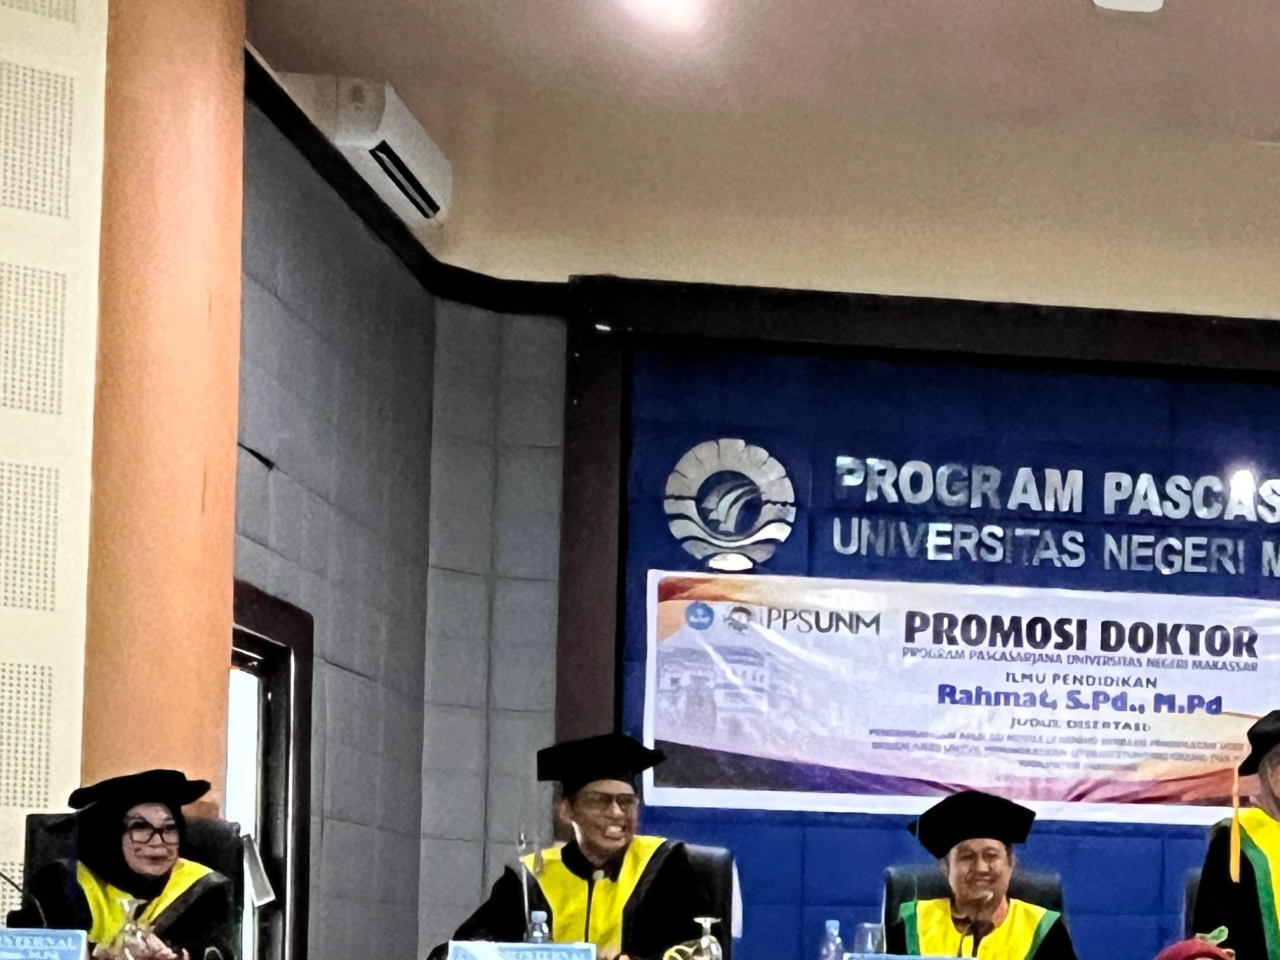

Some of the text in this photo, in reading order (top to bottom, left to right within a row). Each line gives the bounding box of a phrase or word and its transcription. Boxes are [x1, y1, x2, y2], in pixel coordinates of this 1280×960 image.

[835, 455, 1084, 513] PROGRAM
[833, 516, 1086, 568] UNIVERSITAS
[1103, 533, 1246, 575] NEGERI
[904, 610, 1259, 659] PROMOSI DOKTOR
[1005, 671, 1158, 690] ILMU PENDIDIKAN
